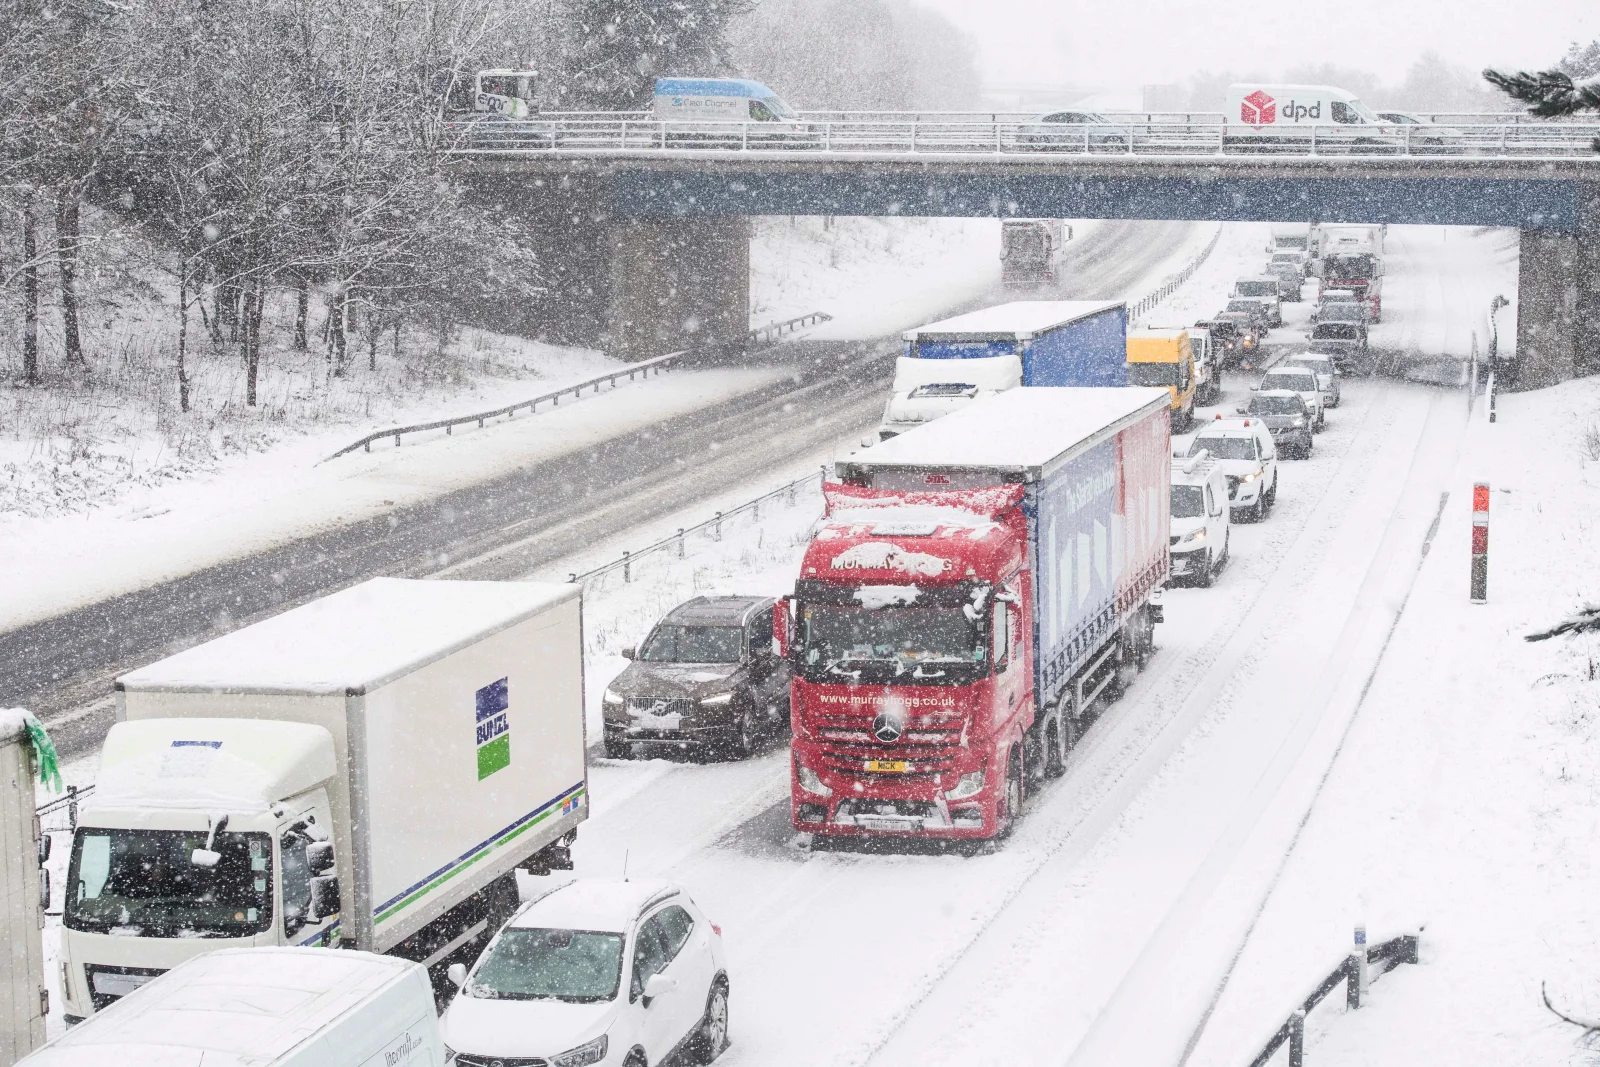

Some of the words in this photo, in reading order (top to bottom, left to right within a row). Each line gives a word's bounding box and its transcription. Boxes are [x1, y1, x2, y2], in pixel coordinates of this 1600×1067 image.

[705, 99, 737, 108] Channel
[1282, 100, 1321, 122] dpd
[820, 694, 956, 708] www.murrayhogg.co.uk
[477, 713, 509, 745] BUNZL
